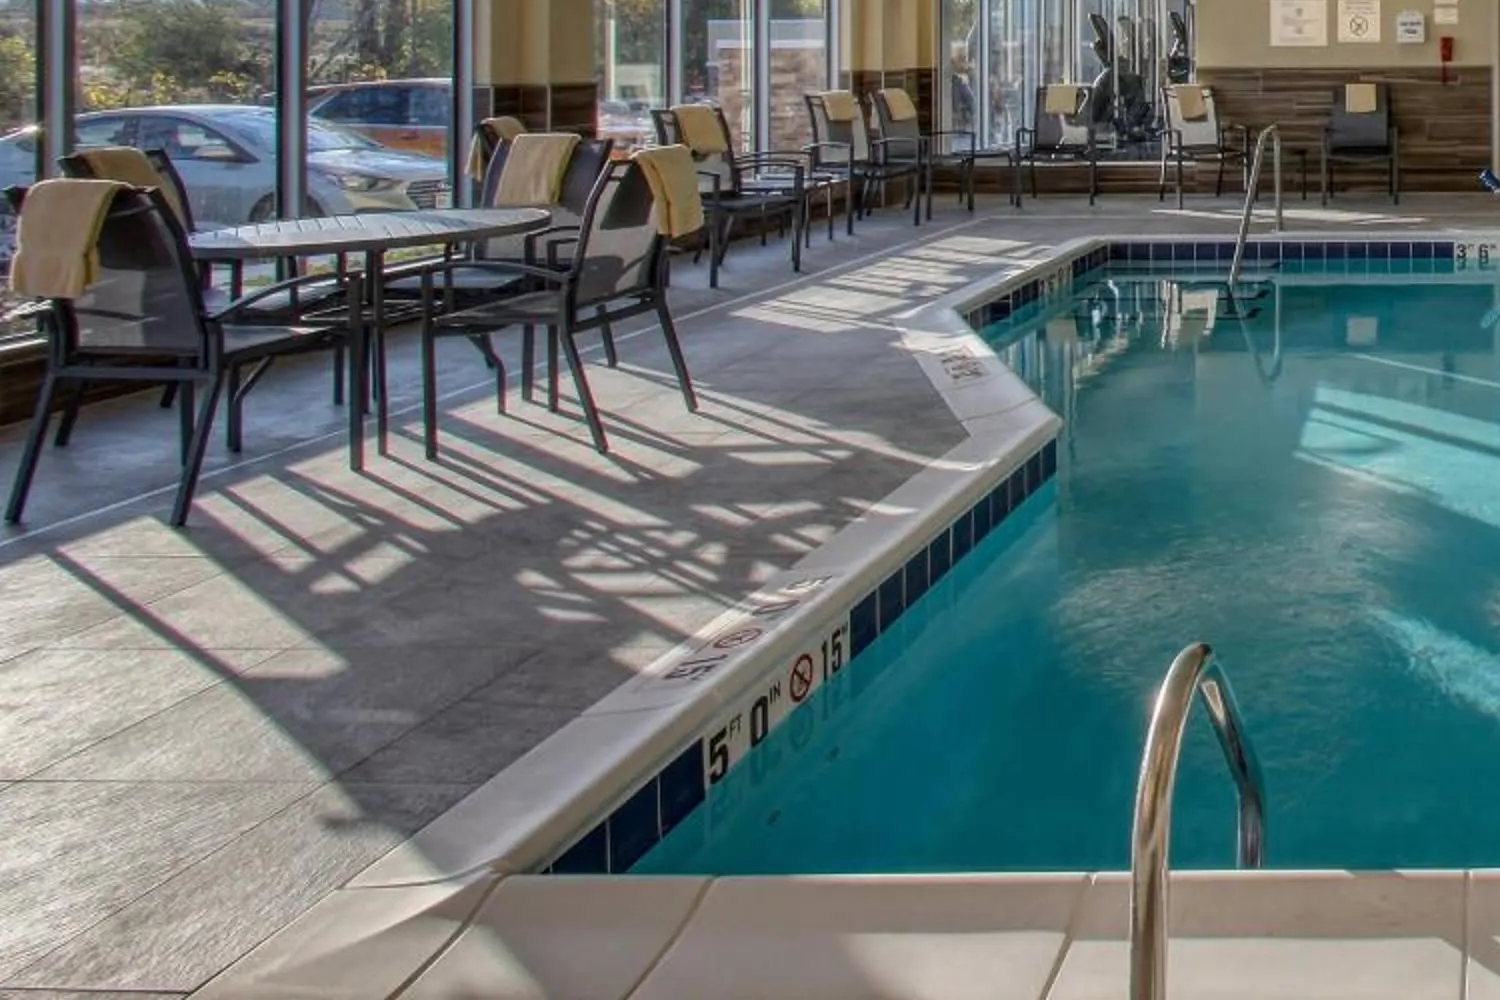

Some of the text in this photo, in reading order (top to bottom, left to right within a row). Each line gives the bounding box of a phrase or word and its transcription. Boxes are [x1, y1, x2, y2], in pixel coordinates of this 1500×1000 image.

[1457, 243, 1467, 259] 3
[1479, 243, 1489, 260] 6
[709, 726, 729, 785] 5
[749, 695, 769, 748] 0
